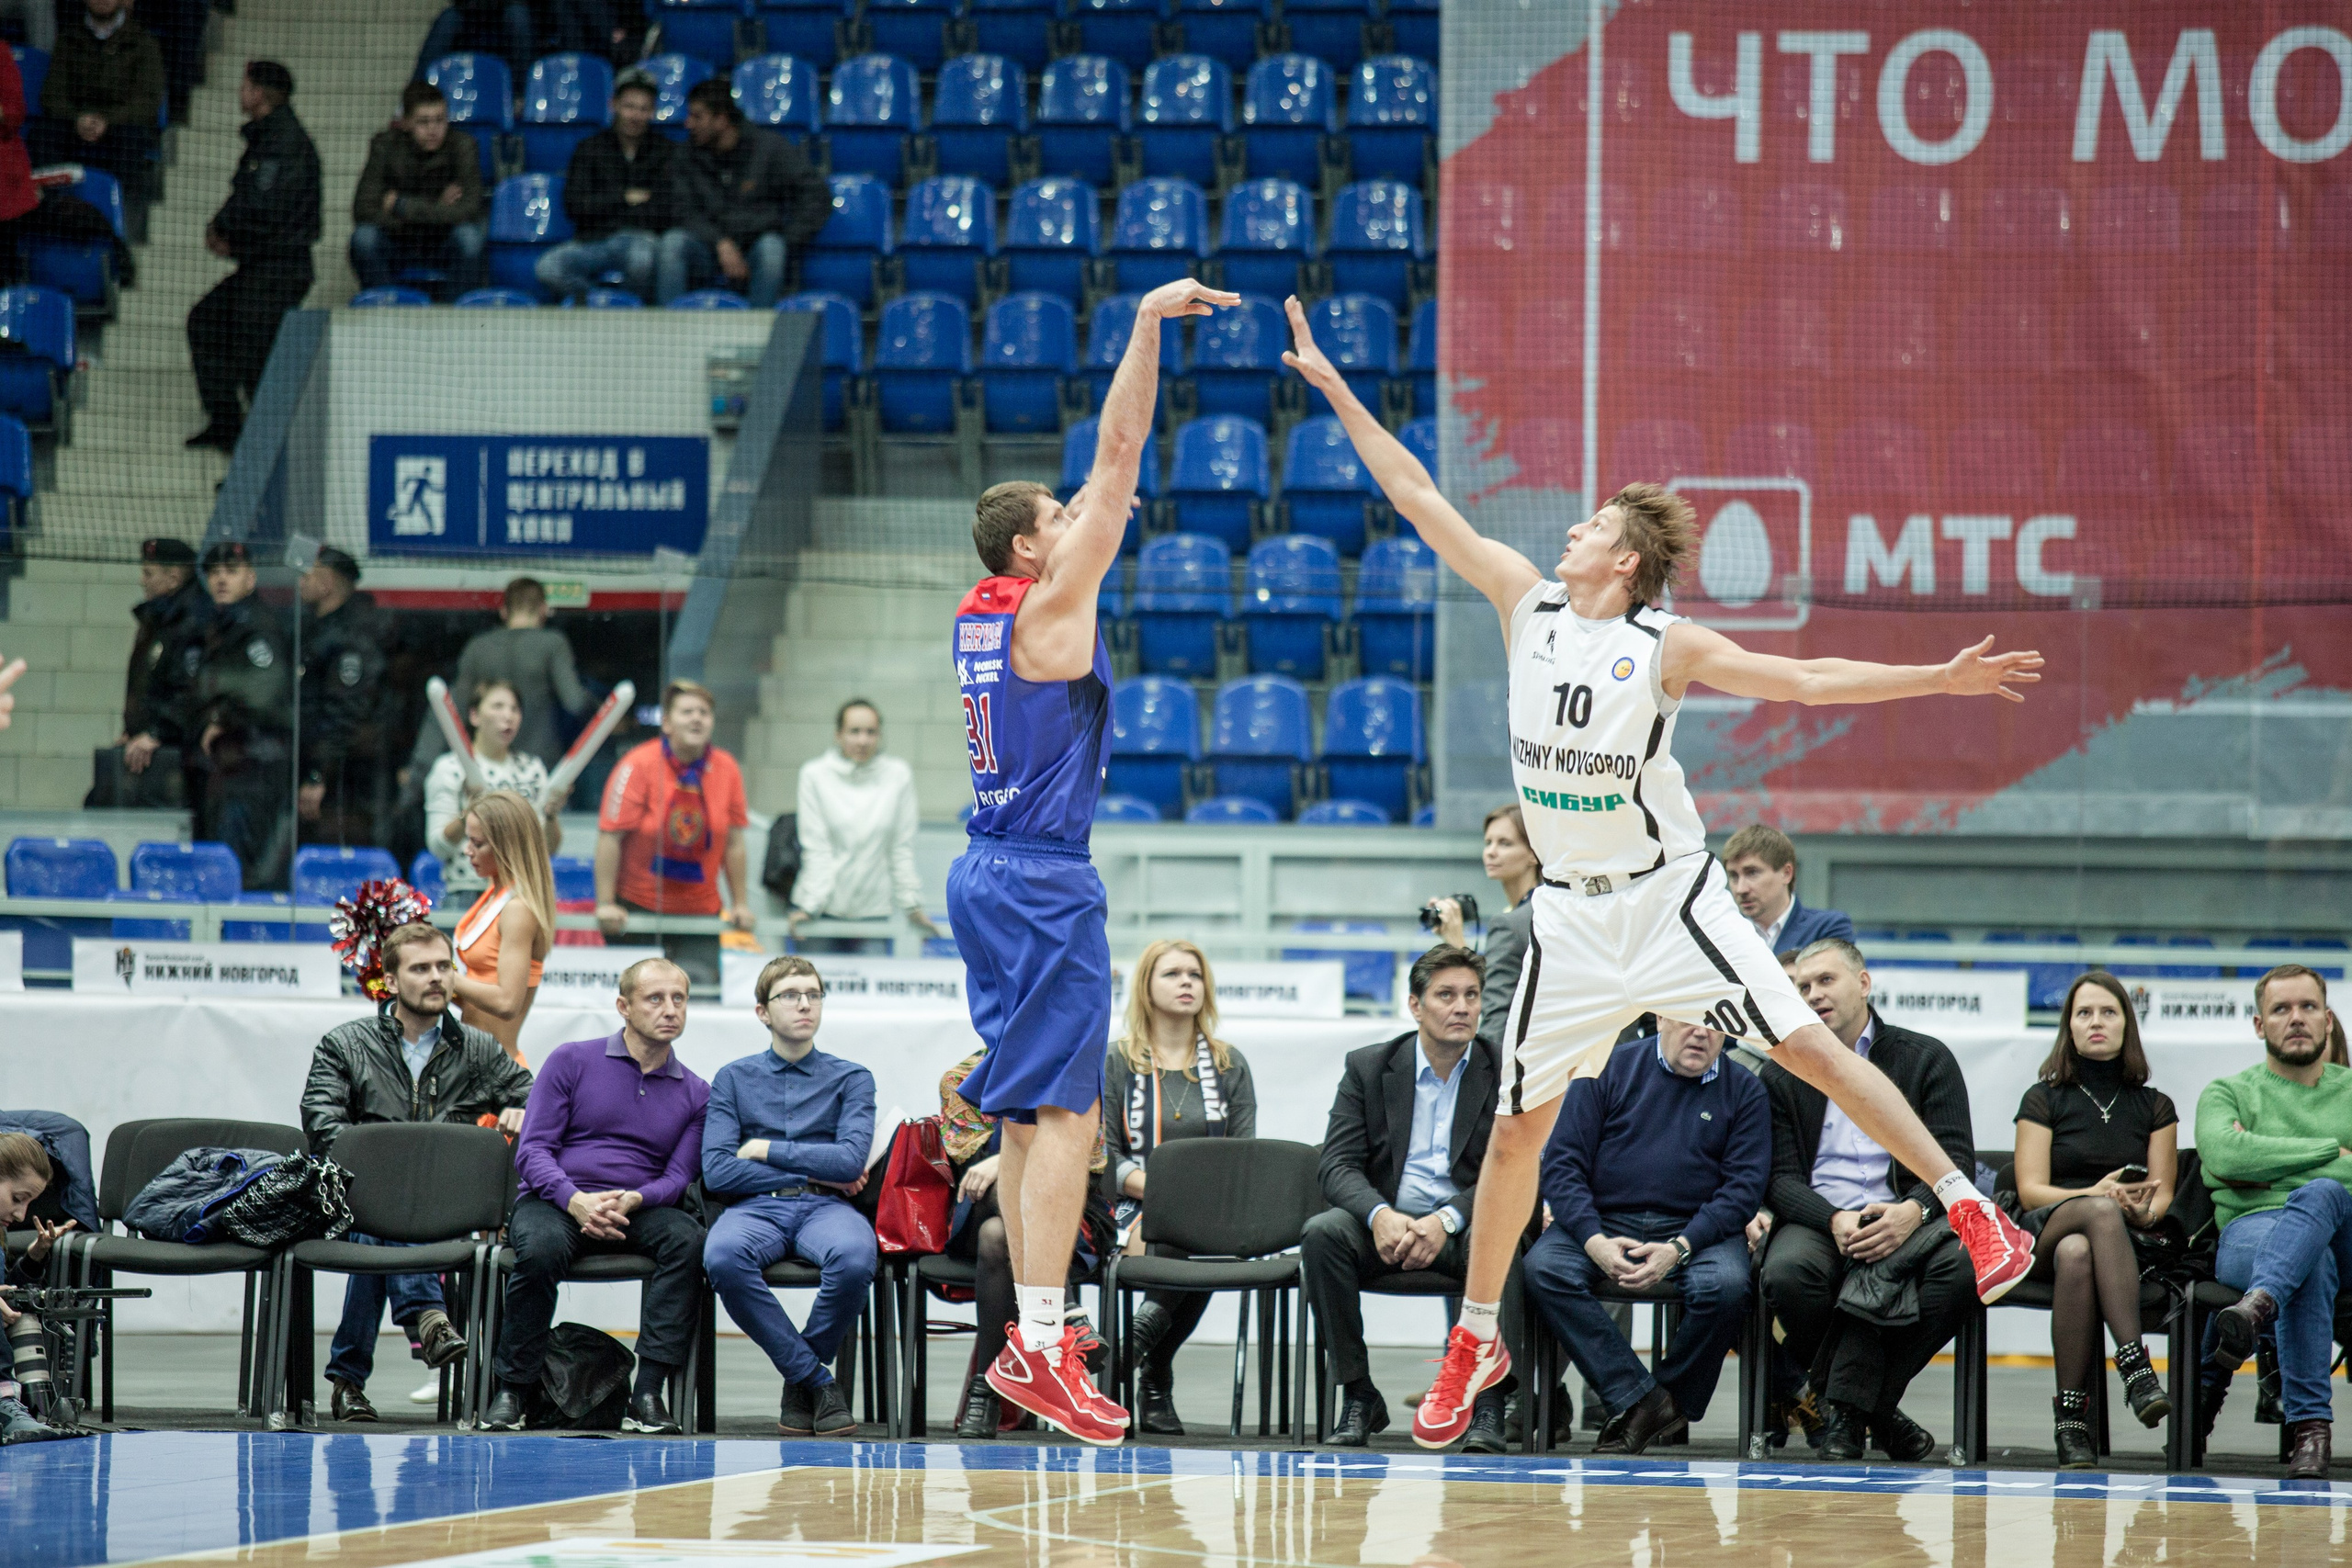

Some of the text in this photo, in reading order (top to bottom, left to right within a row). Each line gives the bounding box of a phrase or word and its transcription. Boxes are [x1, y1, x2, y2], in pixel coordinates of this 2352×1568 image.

[1668, 25, 2352, 165] ЧТО МО
[507, 446, 646, 479] ПЕРЕХОД В
[506, 478, 685, 513] ЦЕНТРАЛЬНЫЙ
[1843, 513, 2076, 597] МТС
[1553, 682, 1592, 728] 10
[961, 692, 998, 773] 31
[1555, 747, 1636, 780] NOVGOROD
[1521, 785, 1627, 812] СИБУР
[144, 963, 300, 987] НИЖНИЙ НОВГОРОД
[1703, 999, 1747, 1037] 10
[1896, 993, 1983, 1014] НОВГОРОД
[2160, 999, 2236, 1020] НИЖНИЙ
